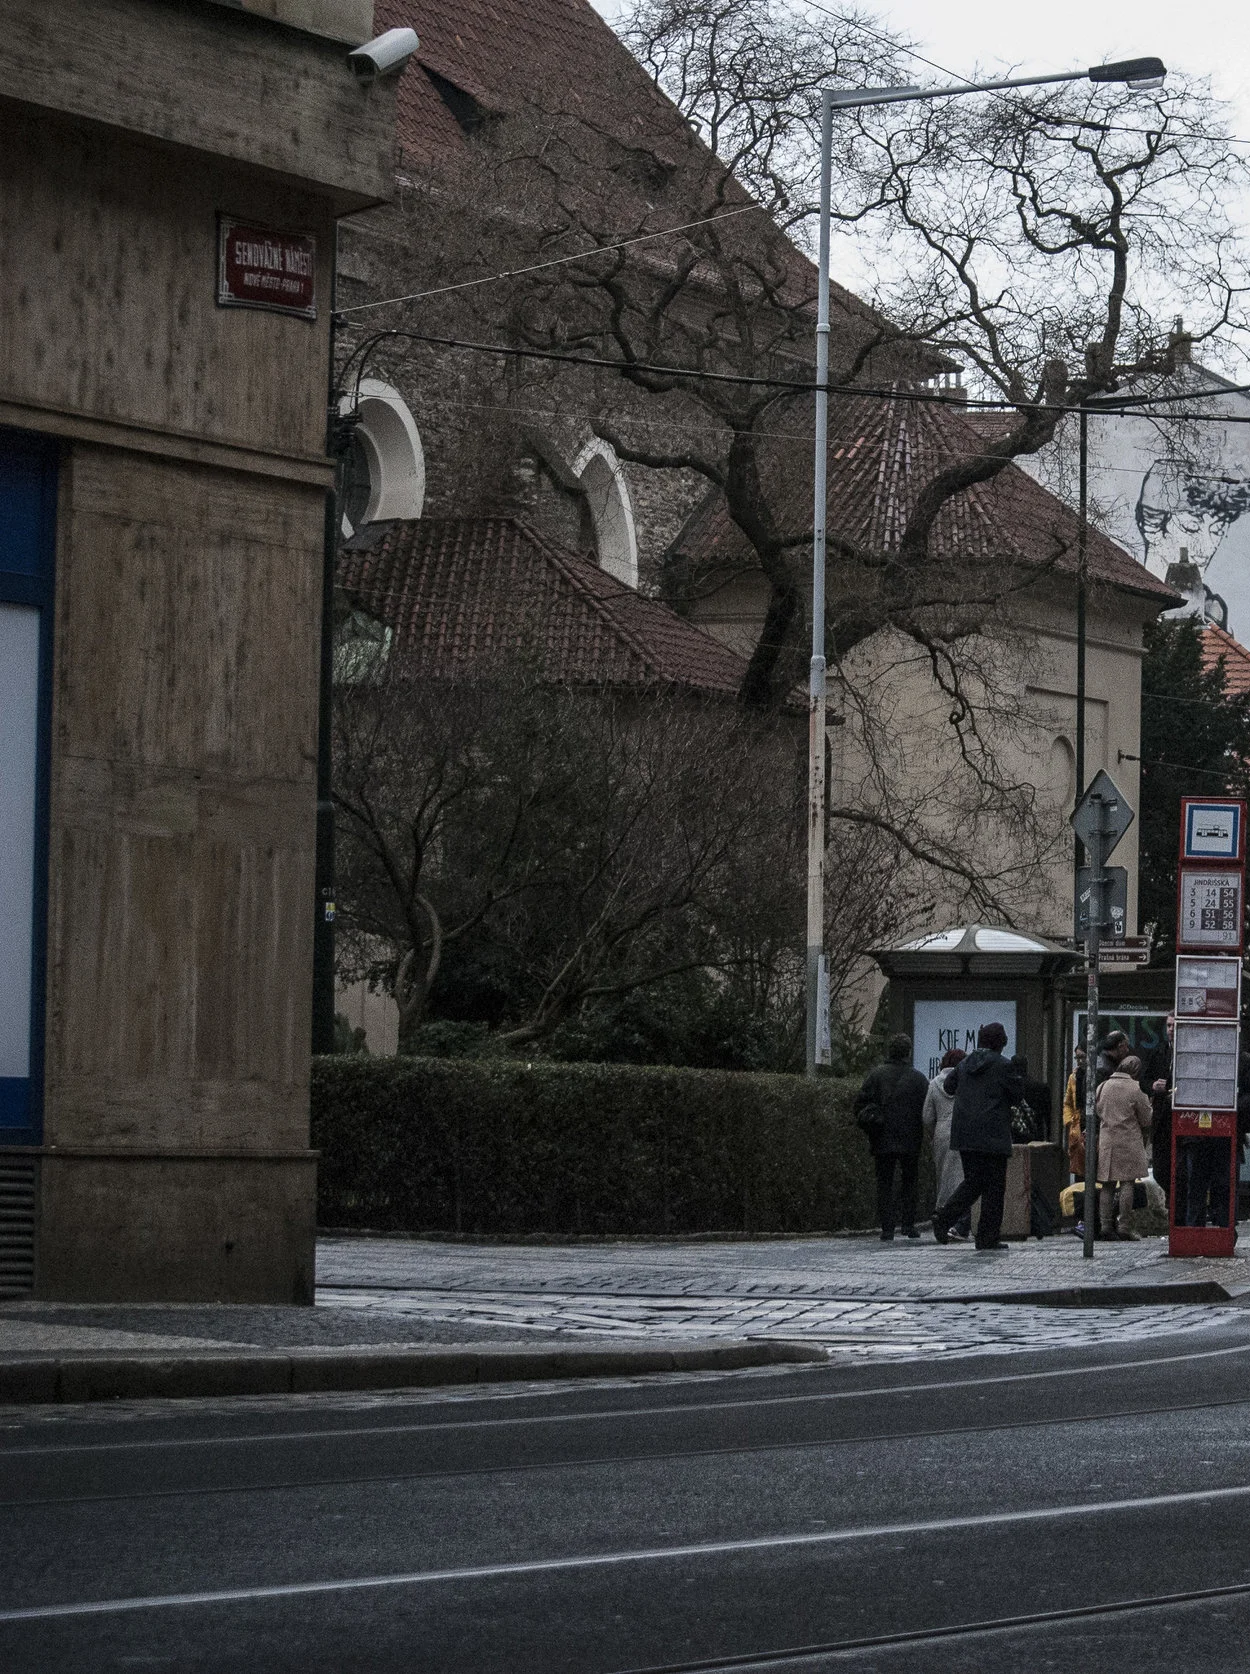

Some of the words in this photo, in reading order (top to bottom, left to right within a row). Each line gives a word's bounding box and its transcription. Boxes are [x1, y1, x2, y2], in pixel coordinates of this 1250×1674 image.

[1190, 888, 1196, 897] 3
[1206, 889, 1217, 897] 14
[1223, 888, 1234, 898] 54
[1190, 899, 1196, 907] 5
[1205, 899, 1216, 908] 24
[1223, 899, 1234, 908] 55
[1190, 909, 1196, 918] 6
[1205, 909, 1216, 918] 51
[1223, 910, 1234, 919] 56
[1189, 920, 1195, 929] 9
[1204, 920, 1216, 929] 52
[1222, 920, 1234, 930] 58
[938, 1029, 960, 1051] KDE
